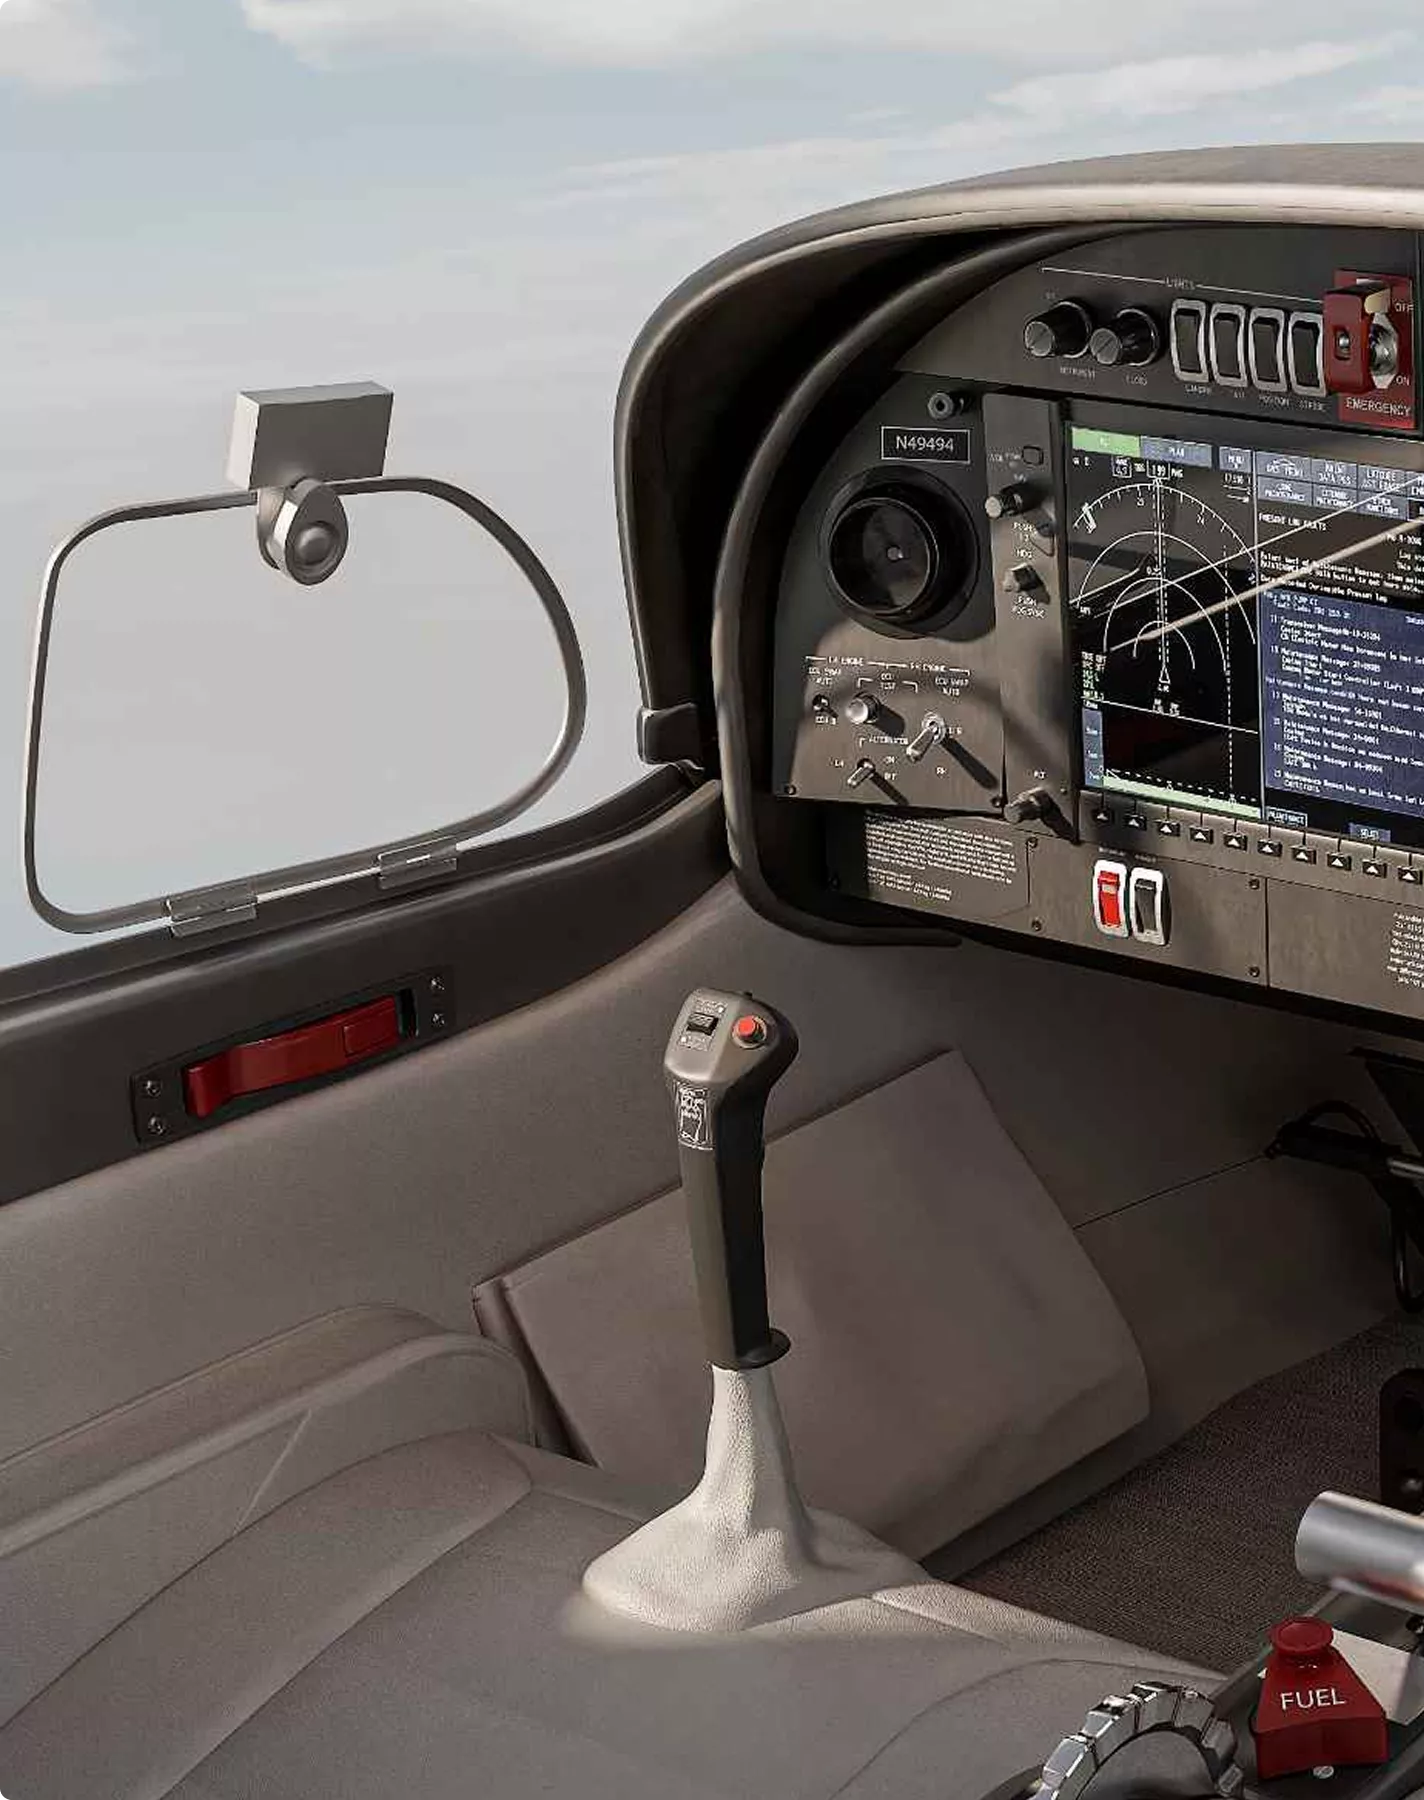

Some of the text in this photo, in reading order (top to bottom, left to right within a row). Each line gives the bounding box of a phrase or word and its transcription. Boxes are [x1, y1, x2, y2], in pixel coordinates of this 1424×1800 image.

[1395, 302, 1414, 312] OFF
[1395, 376, 1410, 386] ON
[1345, 397, 1411, 416] EMERGENCY
[896, 435, 955, 452] N49494
[1279, 1687, 1347, 1712] FUEL
